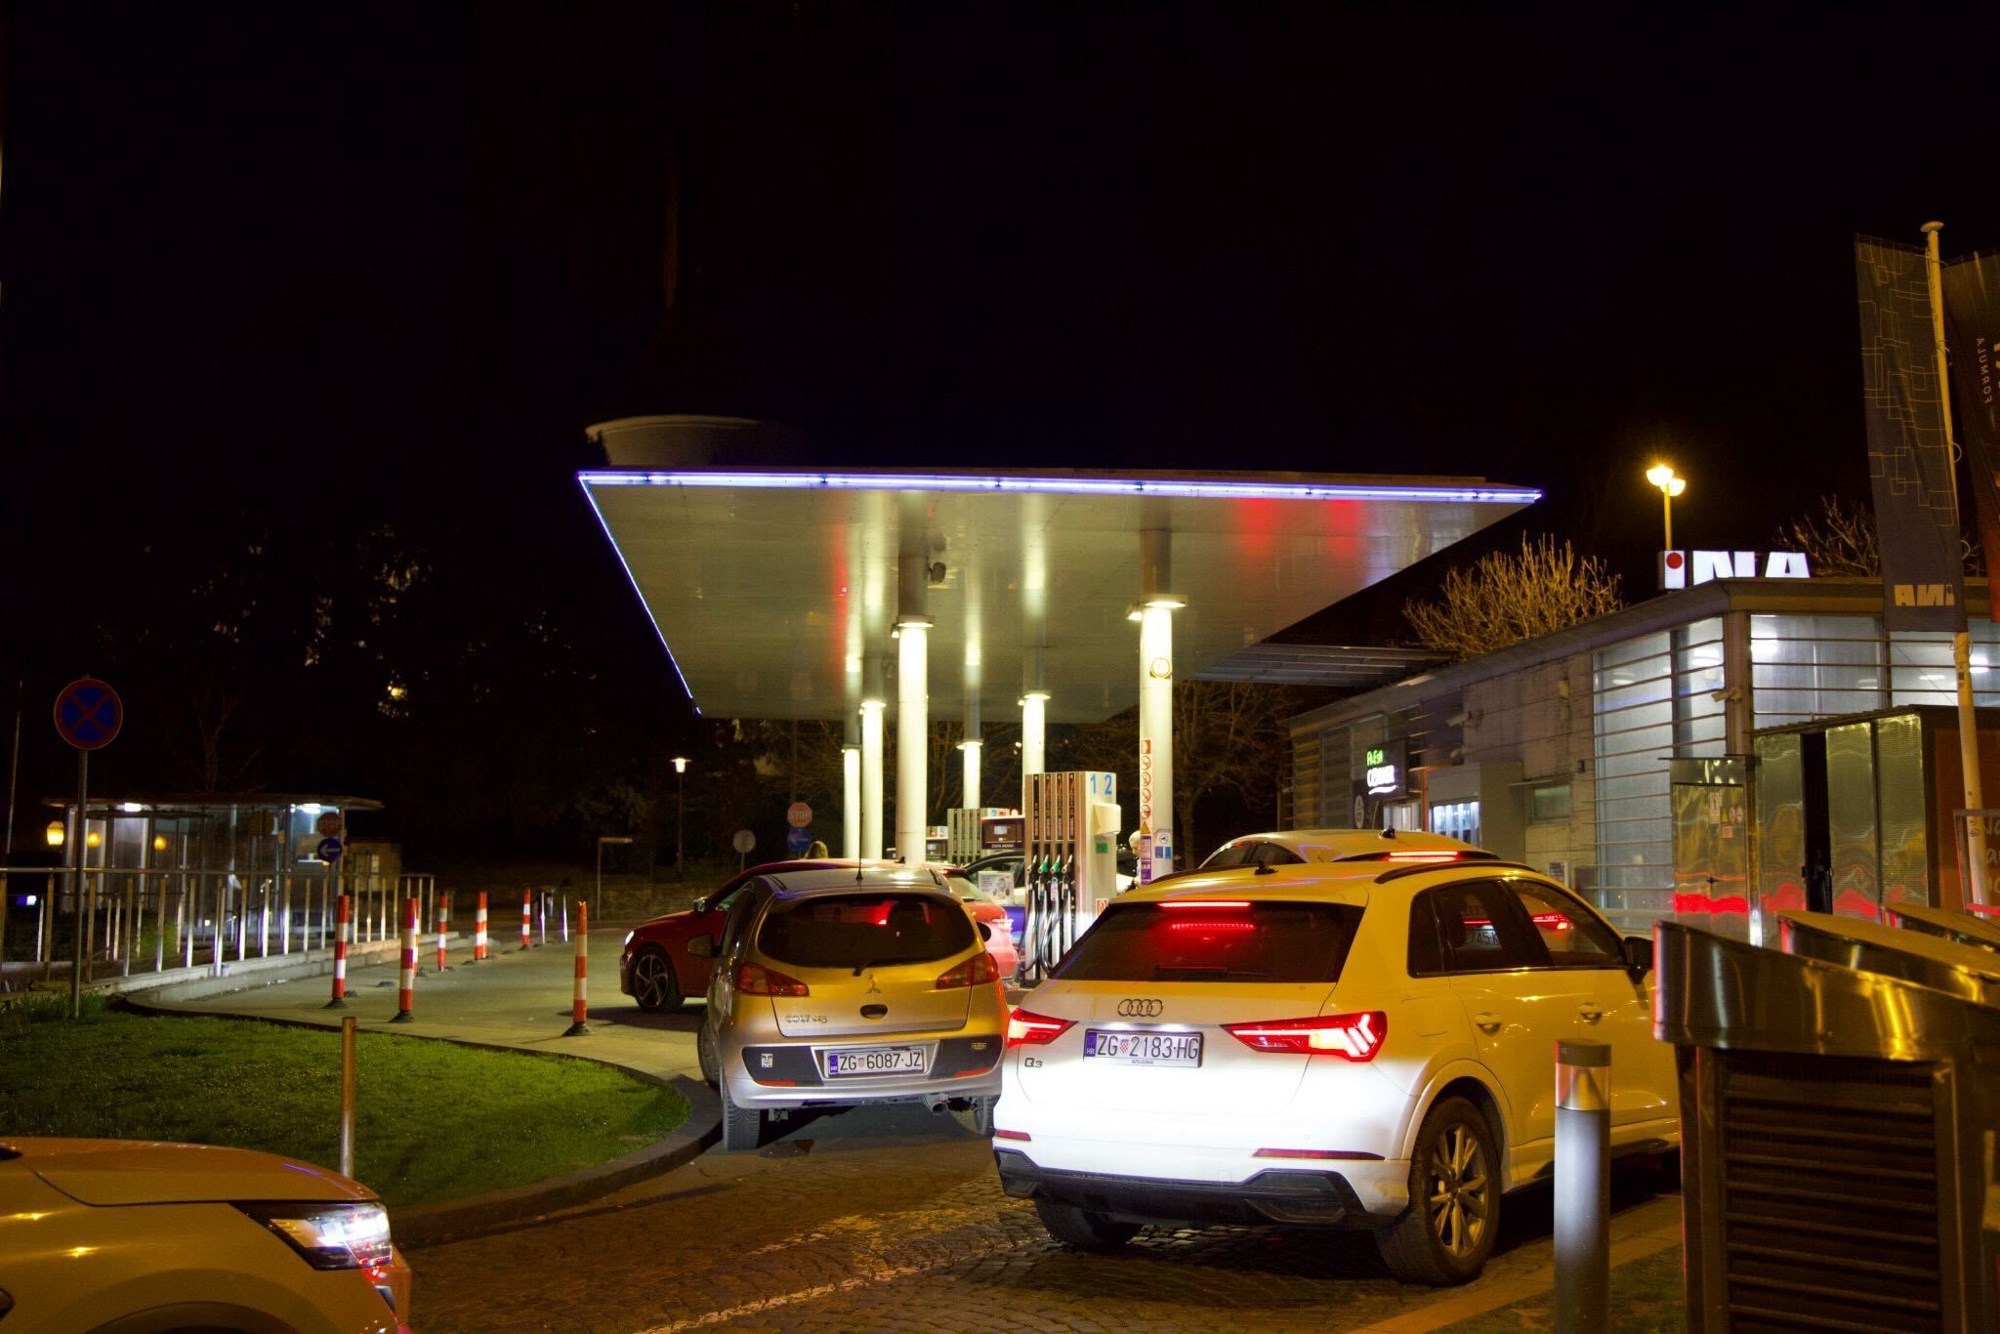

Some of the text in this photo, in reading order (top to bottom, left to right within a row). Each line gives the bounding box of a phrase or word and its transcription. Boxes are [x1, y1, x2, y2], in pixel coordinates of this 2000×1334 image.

[1104, 774, 1112, 795] 2
[790, 810, 810, 820] STOP
[1097, 1035, 1118, 1056] ZG
[839, 1055, 857, 1071] ZG
[1024, 1057, 1043, 1069] Q3
